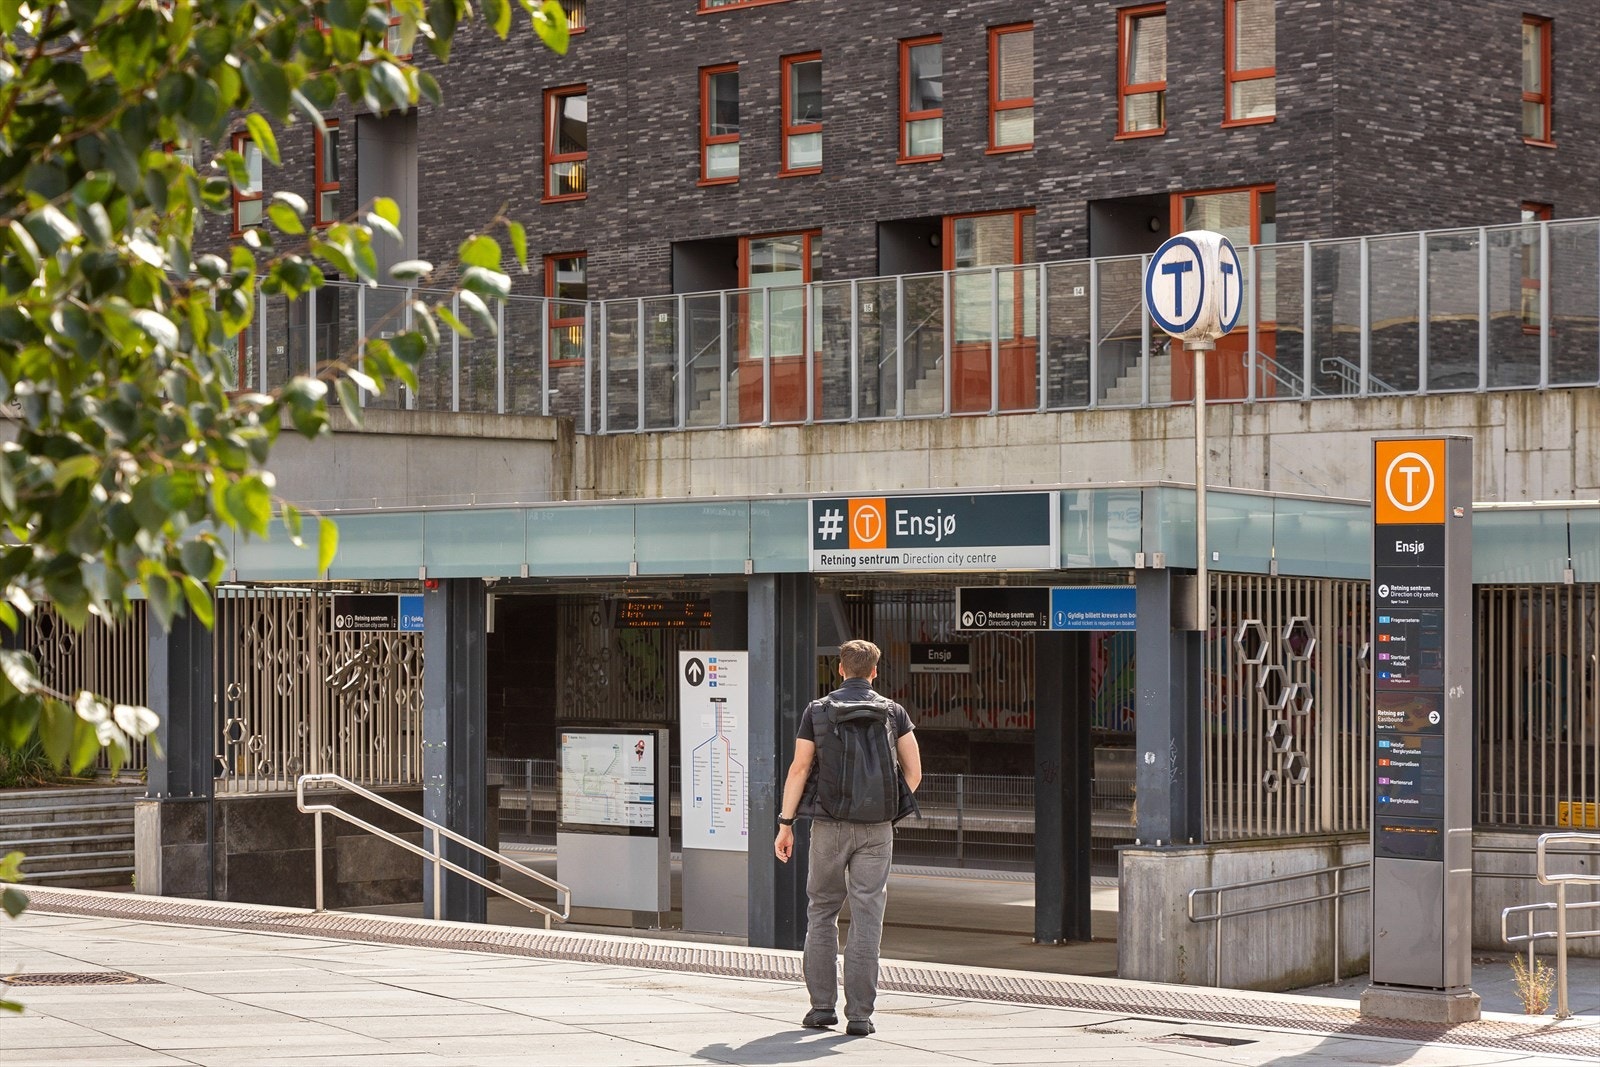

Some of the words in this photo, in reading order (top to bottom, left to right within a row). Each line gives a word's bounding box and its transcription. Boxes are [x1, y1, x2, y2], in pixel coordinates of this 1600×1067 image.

[1162, 260, 1192, 317] T
[1220, 261, 1233, 318] T
[1399, 466, 1420, 503] T
[860, 513, 875, 538] T
[895, 508, 956, 542] Ensjø
[820, 553, 857, 567] Retning
[858, 553, 900, 565] sentrum
[902, 552, 945, 565] Direction
[947, 552, 964, 566] city
[966, 552, 997, 564] centre
[1395, 540, 1425, 555] Ensjø
[928, 649, 952, 662] Ensjø
